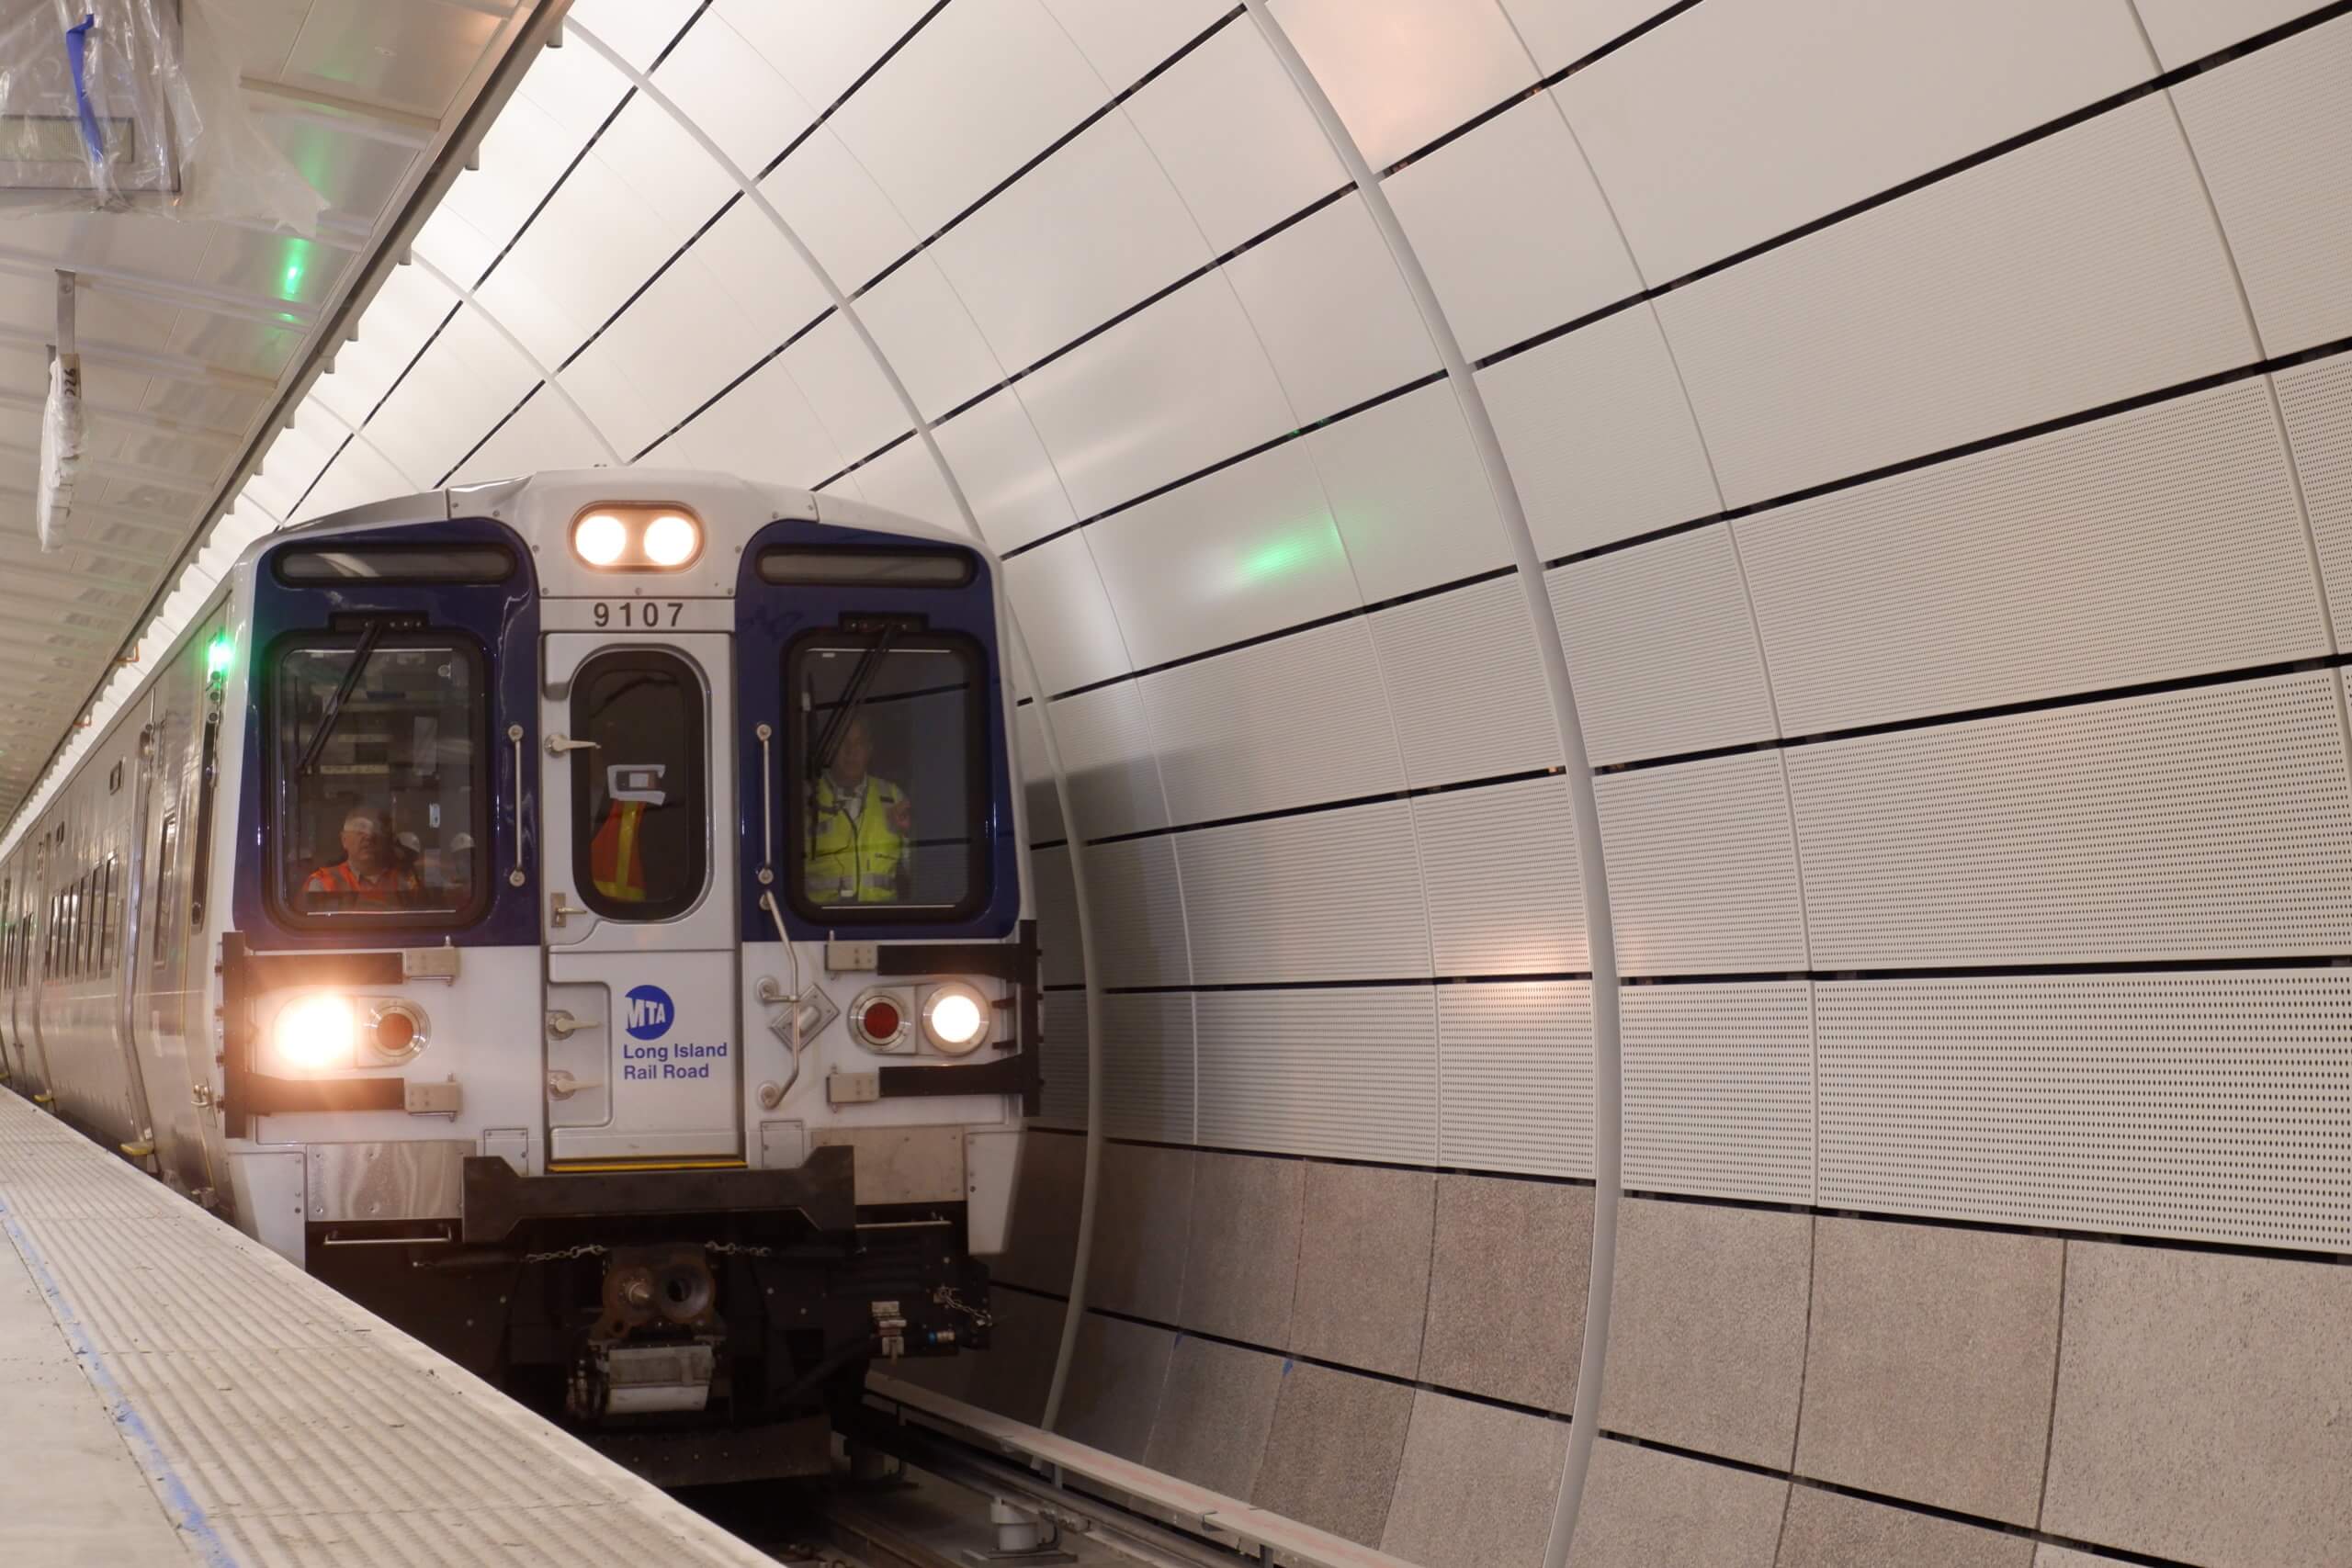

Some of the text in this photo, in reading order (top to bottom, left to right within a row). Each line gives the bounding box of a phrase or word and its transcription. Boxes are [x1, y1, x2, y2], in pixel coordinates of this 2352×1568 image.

[594, 602, 684, 627] 9107
[625, 997, 666, 1030] MTA
[623, 1042, 728, 1062] Long Island
[624, 1063, 709, 1080] Rail Road
